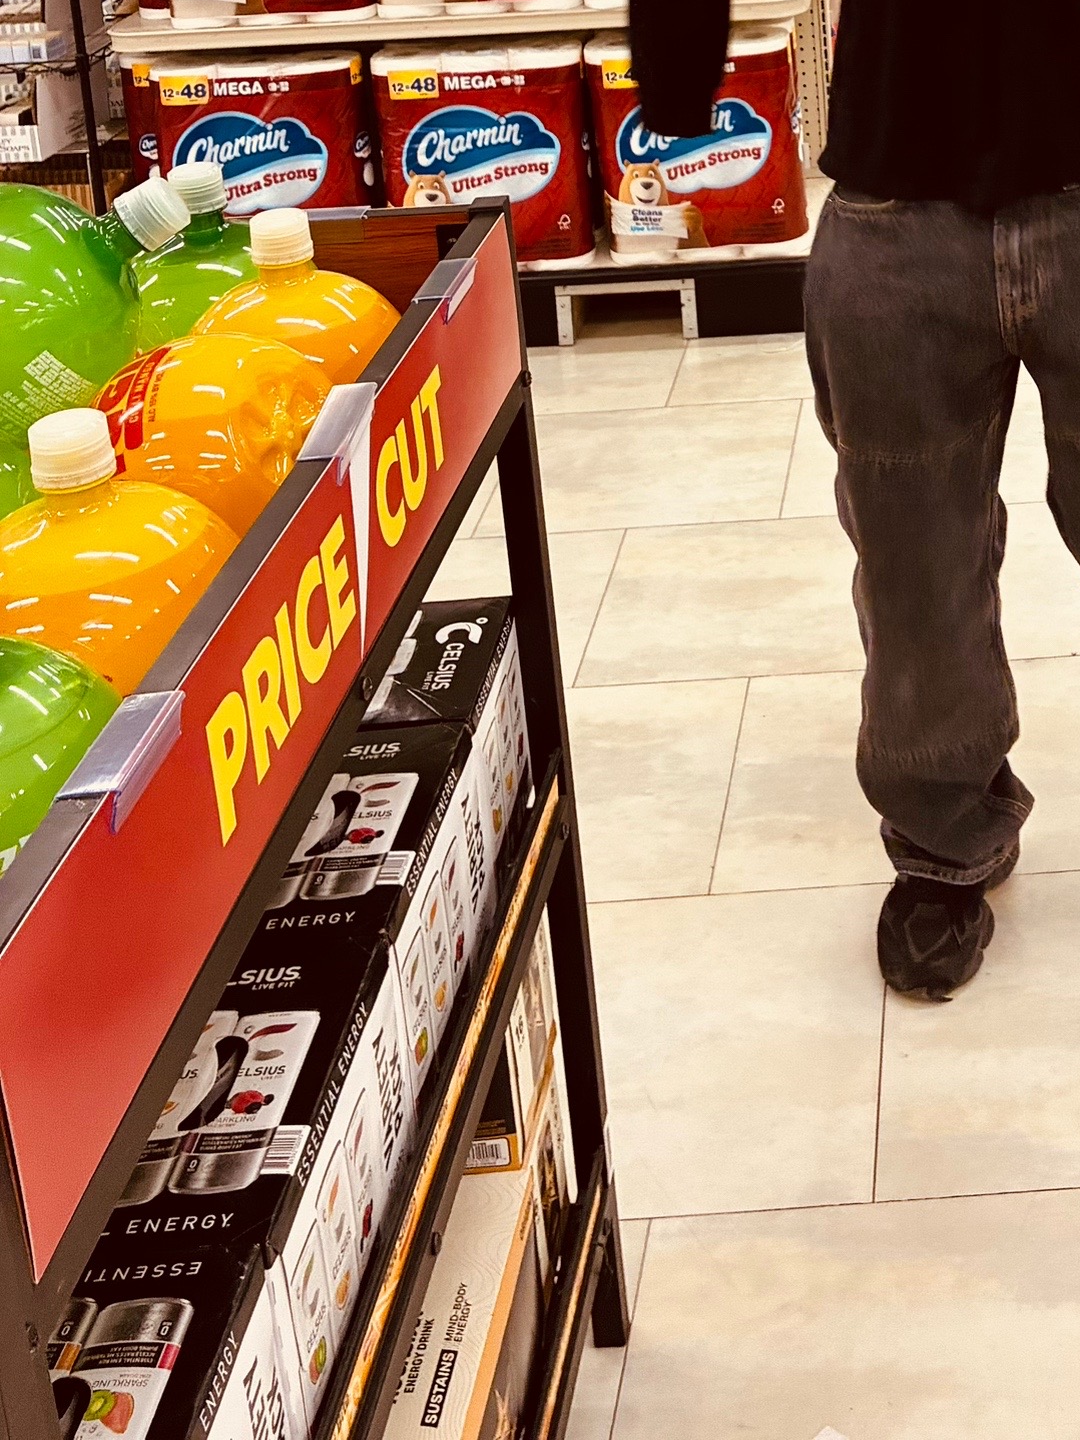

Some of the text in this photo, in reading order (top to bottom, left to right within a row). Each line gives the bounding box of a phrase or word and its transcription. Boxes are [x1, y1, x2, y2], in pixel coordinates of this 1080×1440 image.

[213, 80, 264, 97] MEGA
[444, 74, 497, 90] MEGA
[187, 124, 291, 165] Charmin
[416, 117, 524, 166] Charmin
[226, 166, 318, 203] Ultra Strong
[451, 161, 549, 194] Ultra Strong
[666, 147, 762, 181] Ultra Strong
[205, 364, 446, 848] PRICE CUT
[431, 642, 465, 691] CELSIUS
[475, 615, 512, 717] ESSENTIAL ENERGY
[352, 809, 392, 820] ELSIUS
[406, 767, 459, 897] ESSENTIAL ENERGY
[265, 911, 356, 930] ENERGY
[252, 980, 295, 991] LIVE FIT
[297, 1002, 368, 1187] ESSENTIAL ENERGY
[126, 1212, 235, 1235] ENERGY
[84, 1260, 203, 1283] ESSENTI
[444, 1282, 468, 1342] MIND-BODY
[454, 1300, 472, 1343] ENERGY
[404, 1318, 435, 1394] ENERGY DRINK
[91, 1378, 150, 1389] SPARKLING
[199, 1330, 239, 1432] ENERGY
[424, 1351, 456, 1426] SUSTAINS
